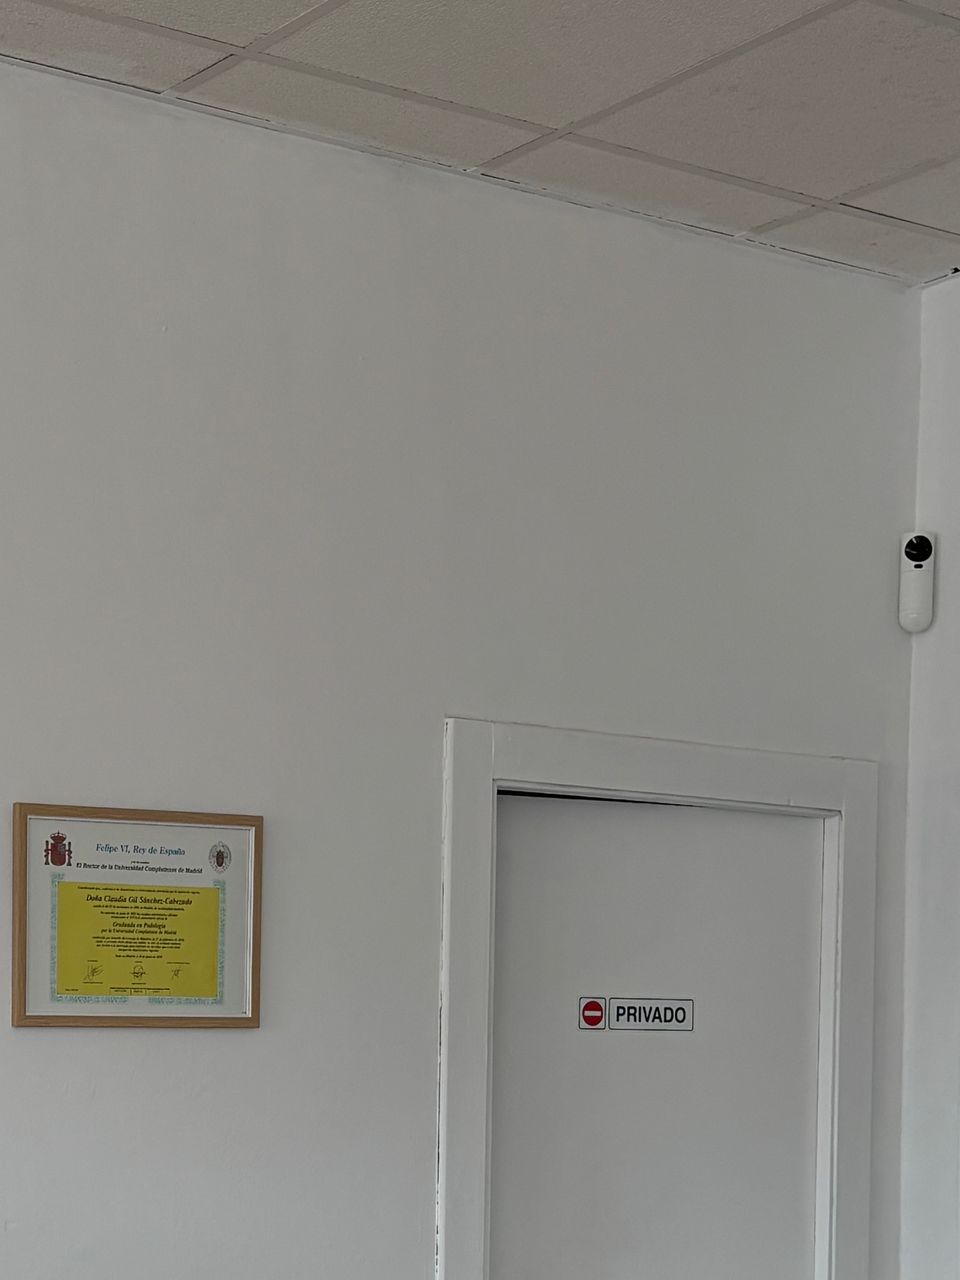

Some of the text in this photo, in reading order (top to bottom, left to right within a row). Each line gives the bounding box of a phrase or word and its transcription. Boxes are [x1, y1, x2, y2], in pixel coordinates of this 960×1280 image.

[96, 843, 185, 857] Felipe VI, Rey de España
[114, 864, 143, 872] Universidad
[86, 894, 102, 902] Doña
[104, 895, 127, 903] Claudia
[616, 1006, 686, 1023] PRIVADO
